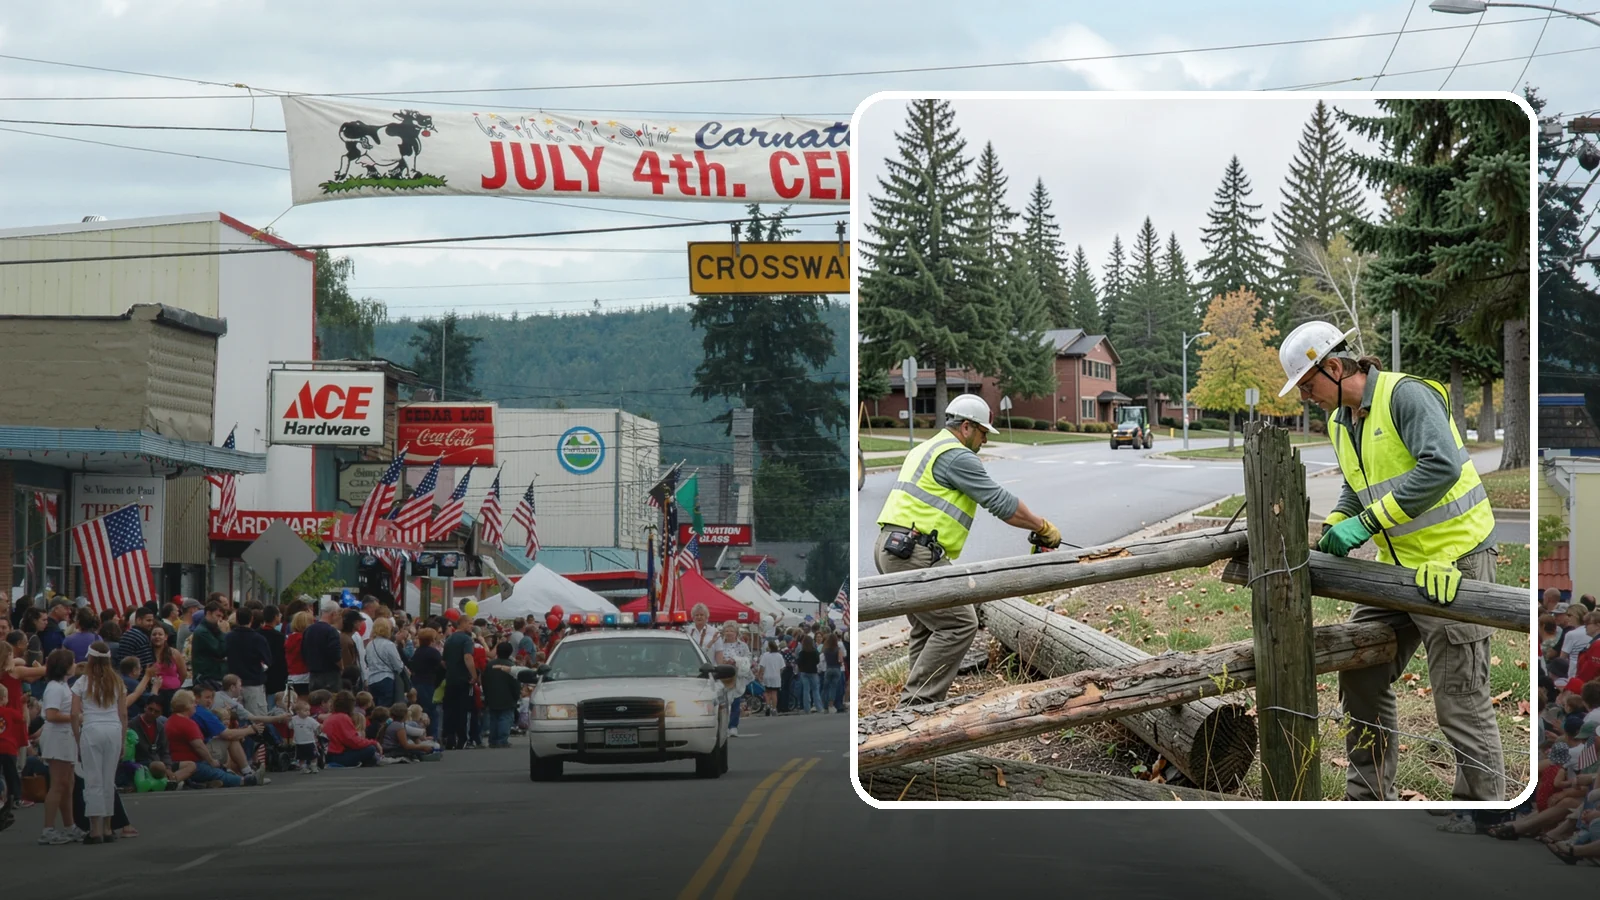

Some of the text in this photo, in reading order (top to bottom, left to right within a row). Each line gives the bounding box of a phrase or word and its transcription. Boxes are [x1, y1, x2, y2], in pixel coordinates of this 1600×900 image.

[481, 140, 604, 192] JULY
[632, 149, 747, 198] 4th.
[697, 254, 850, 280] CROSSWA
[282, 379, 374, 420] ACE
[405, 409, 486, 422] CEDAR LOG
[283, 421, 371, 437] Hardware
[82, 484, 155, 495] St. Vincent de Paul
[688, 526, 742, 535] CRNATION
[699, 534, 731, 544] GLASS
